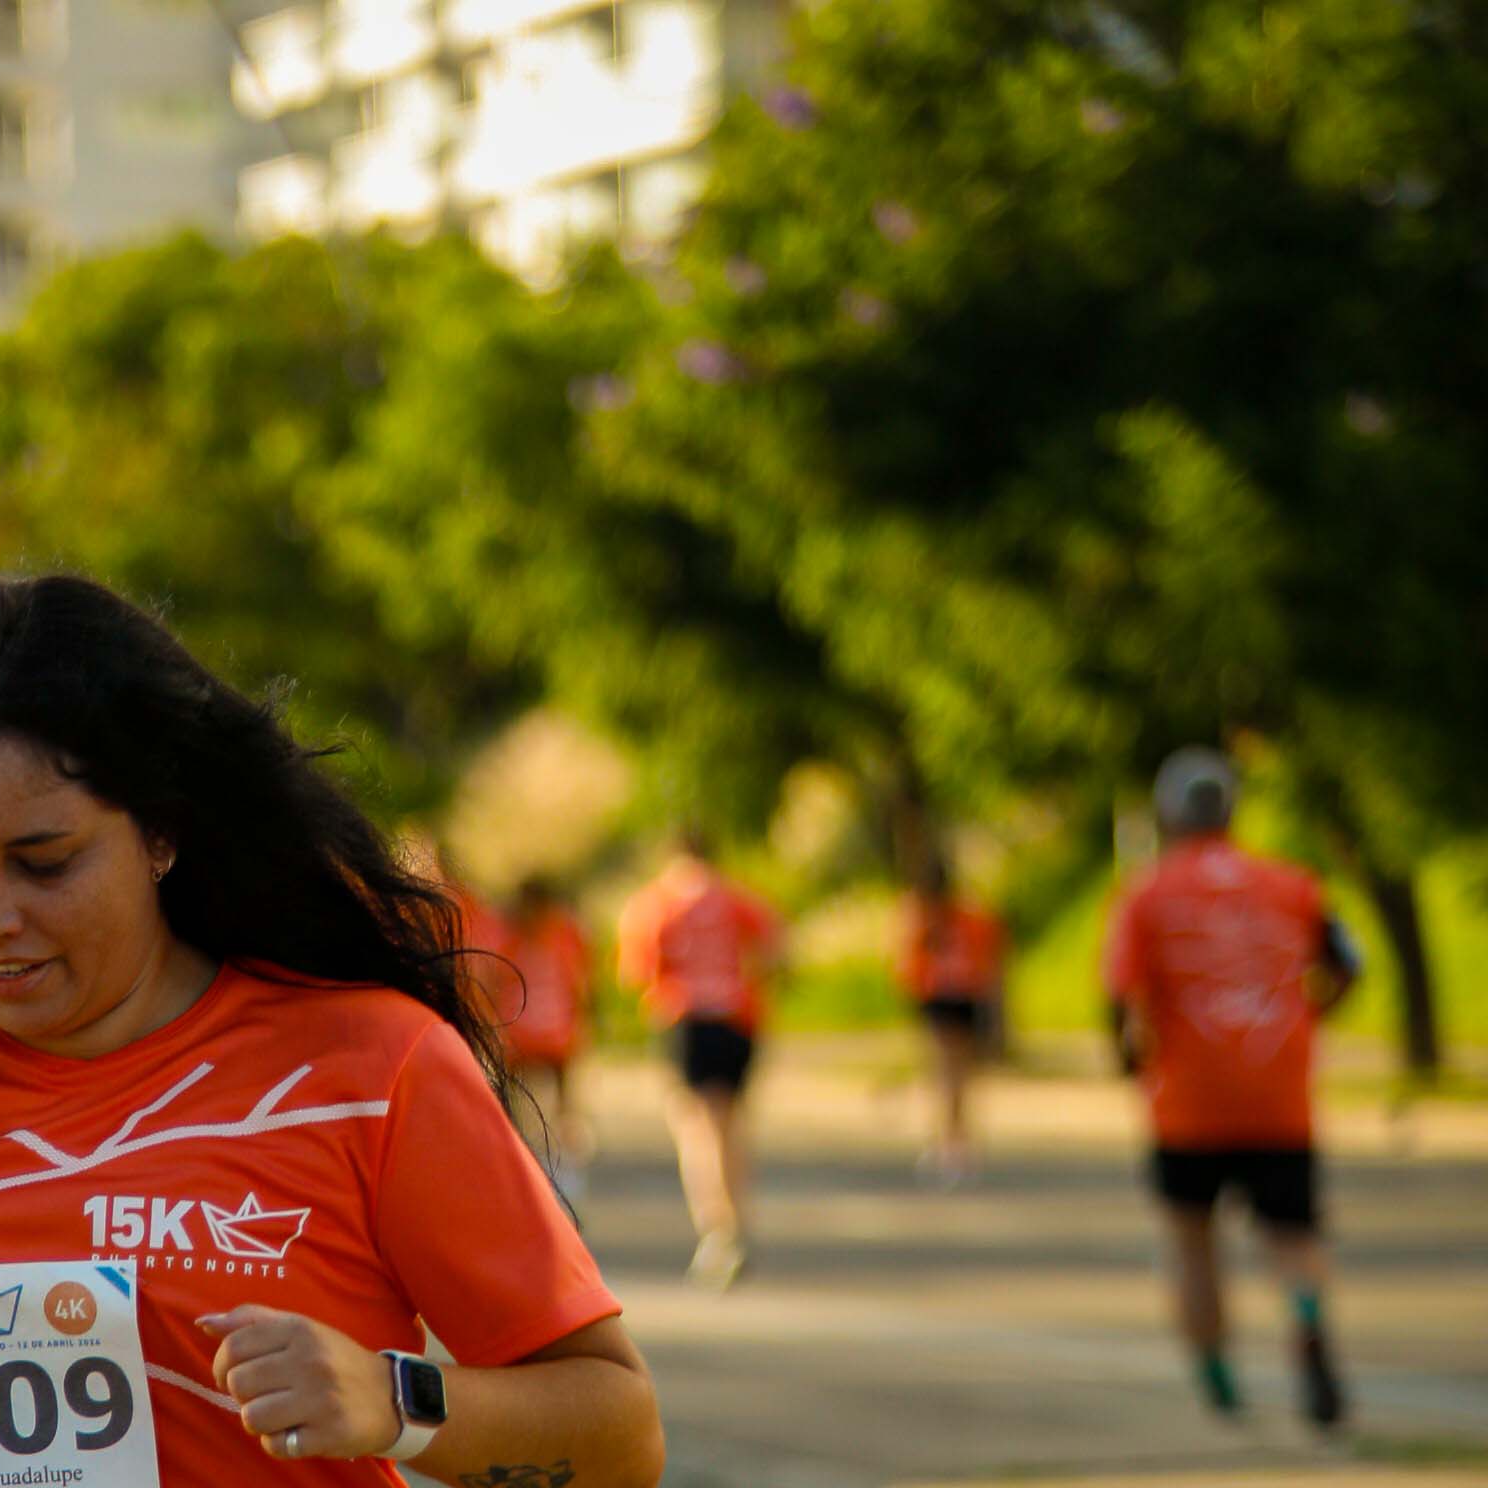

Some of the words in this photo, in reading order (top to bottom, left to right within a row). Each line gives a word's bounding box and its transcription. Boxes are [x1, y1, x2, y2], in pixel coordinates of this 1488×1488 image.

[83, 1195, 196, 1250] 15K
[206, 1259, 286, 1278] NORTE
[53, 1298, 89, 1320] 4K
[31, 1340, 44, 1349] DE
[47, 1339, 74, 1348] ABRIL
